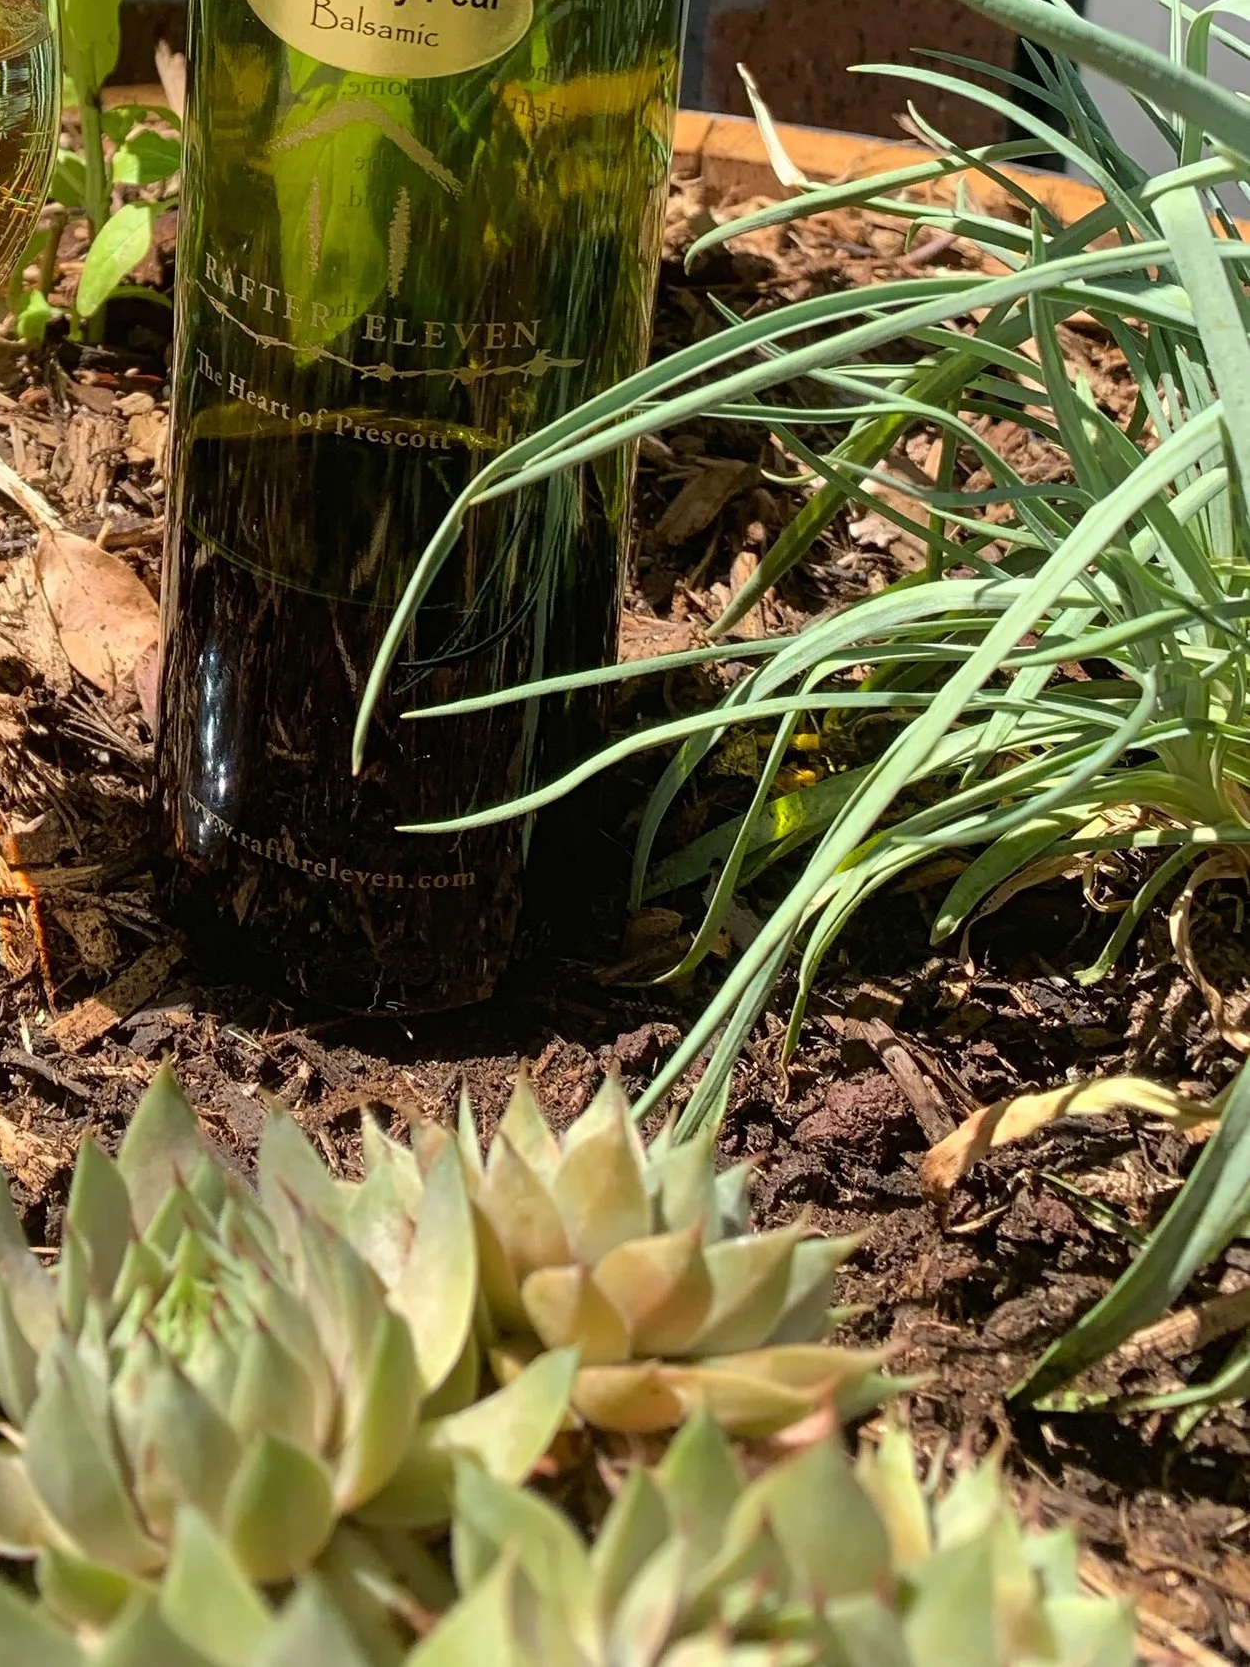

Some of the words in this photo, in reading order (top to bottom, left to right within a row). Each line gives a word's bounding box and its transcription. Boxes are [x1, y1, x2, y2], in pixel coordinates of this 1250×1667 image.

[204, 251, 332, 329] RAFTER
[361, 313, 543, 351] ELEVEN
[197, 348, 223, 387] The
[227, 371, 291, 421] Heart
[298, 407, 329, 432] of
[335, 413, 452, 451] Prescott
